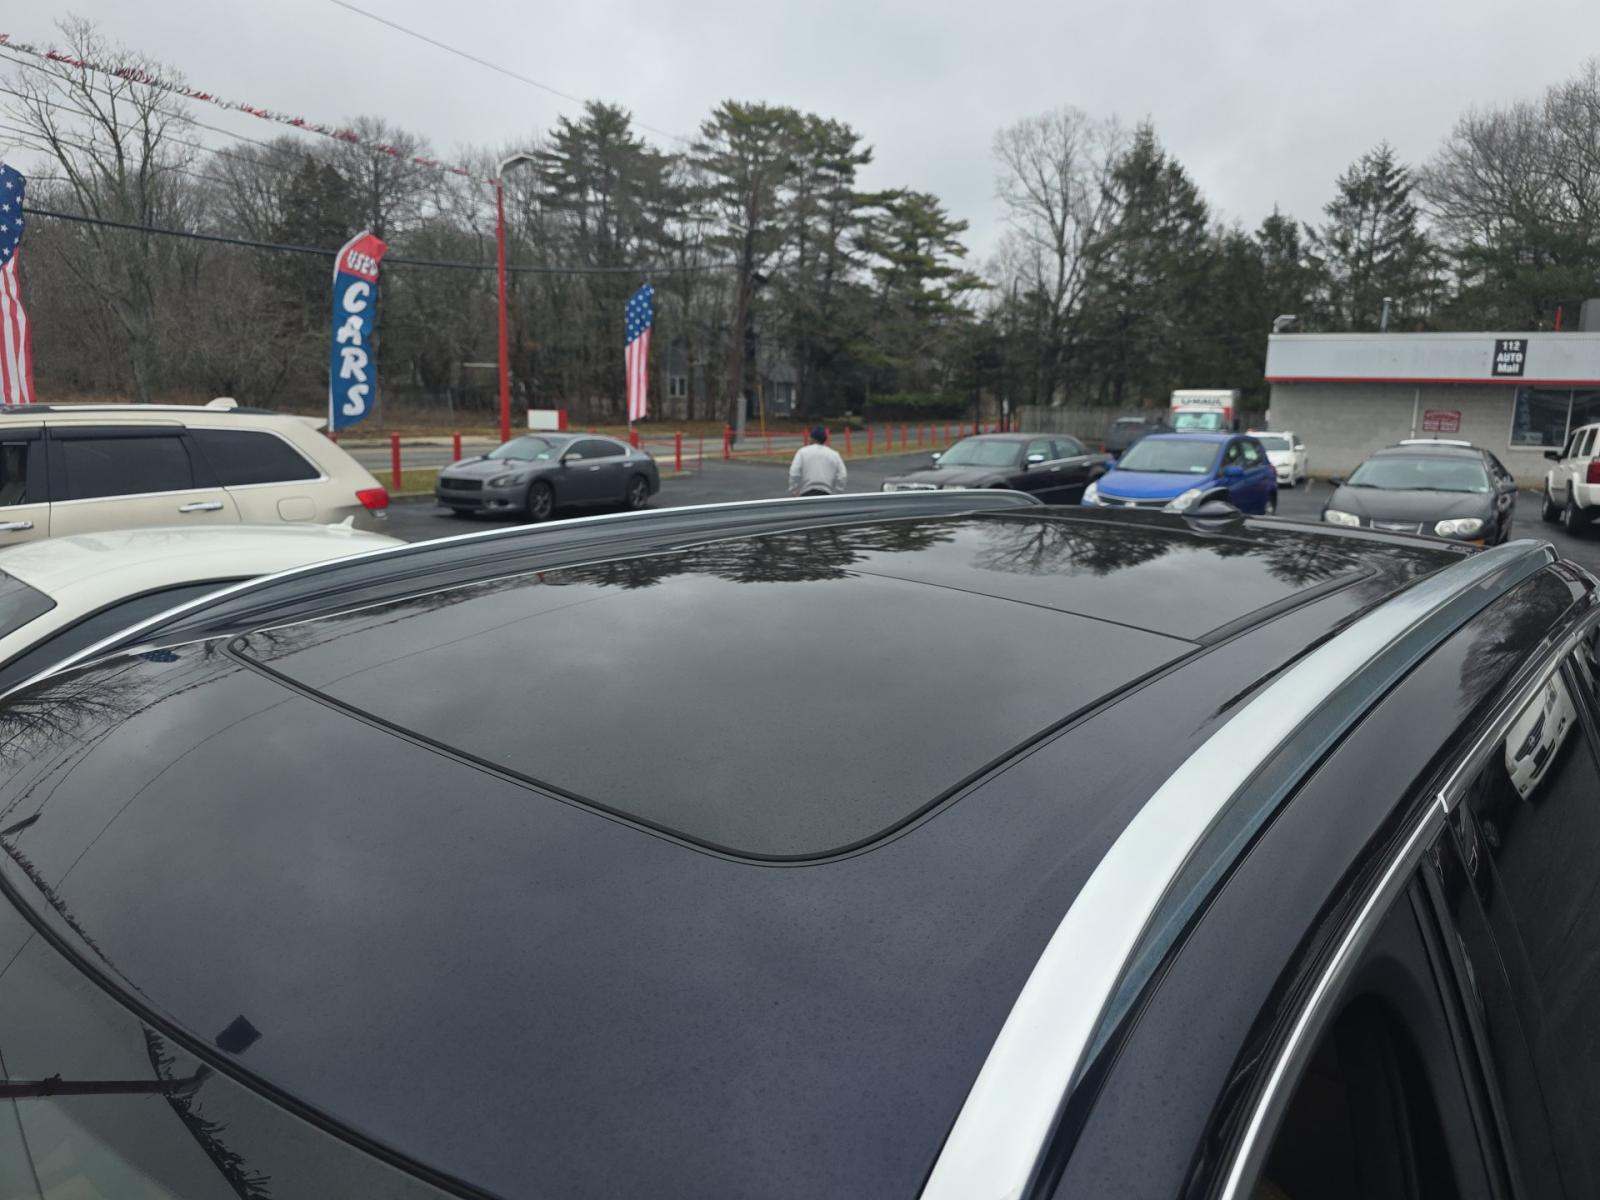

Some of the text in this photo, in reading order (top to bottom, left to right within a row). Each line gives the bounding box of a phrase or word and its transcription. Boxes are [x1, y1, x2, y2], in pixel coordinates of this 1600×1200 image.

[347, 249, 379, 276] USED
[336, 281, 370, 416] CARS
[1502, 340, 1521, 351] 112
[1496, 352, 1523, 363] AUTO
